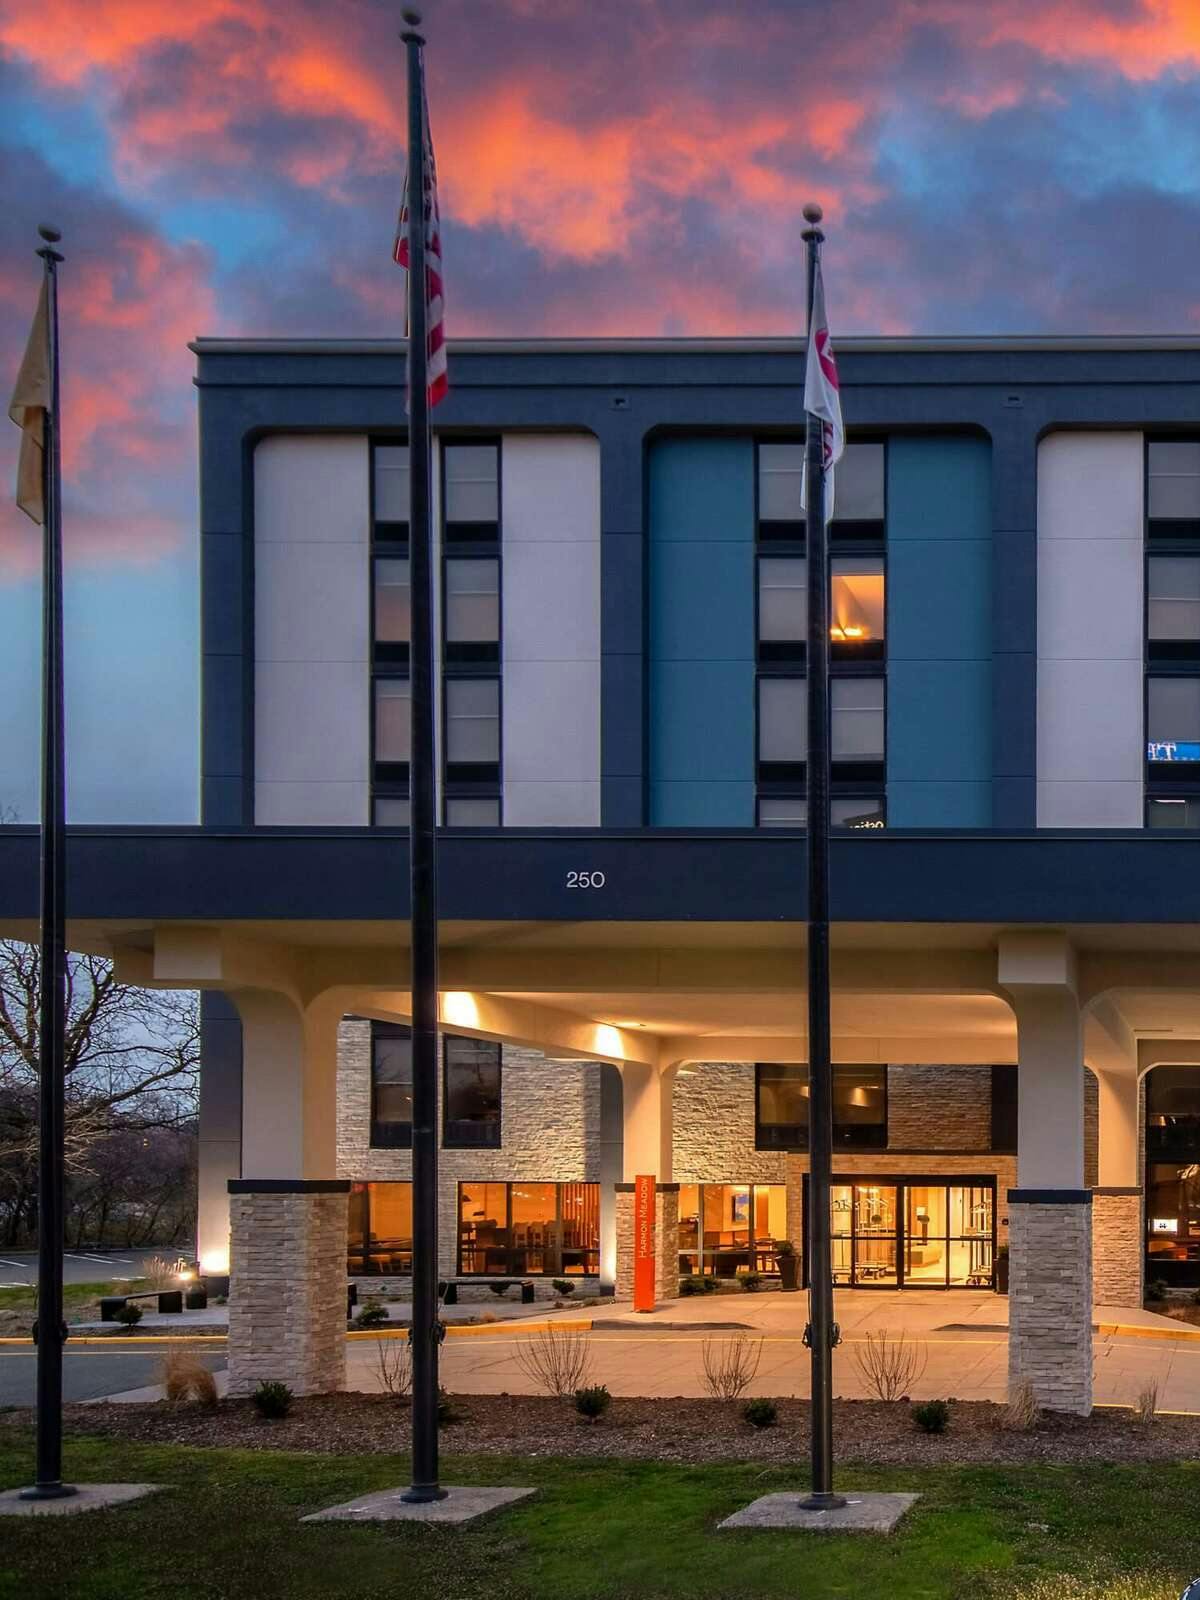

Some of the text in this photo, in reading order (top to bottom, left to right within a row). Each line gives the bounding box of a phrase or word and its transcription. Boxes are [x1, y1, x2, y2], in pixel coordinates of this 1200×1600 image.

[566, 871, 605, 888] 250
[639, 1177, 649, 1258] HARMON MEADOW
